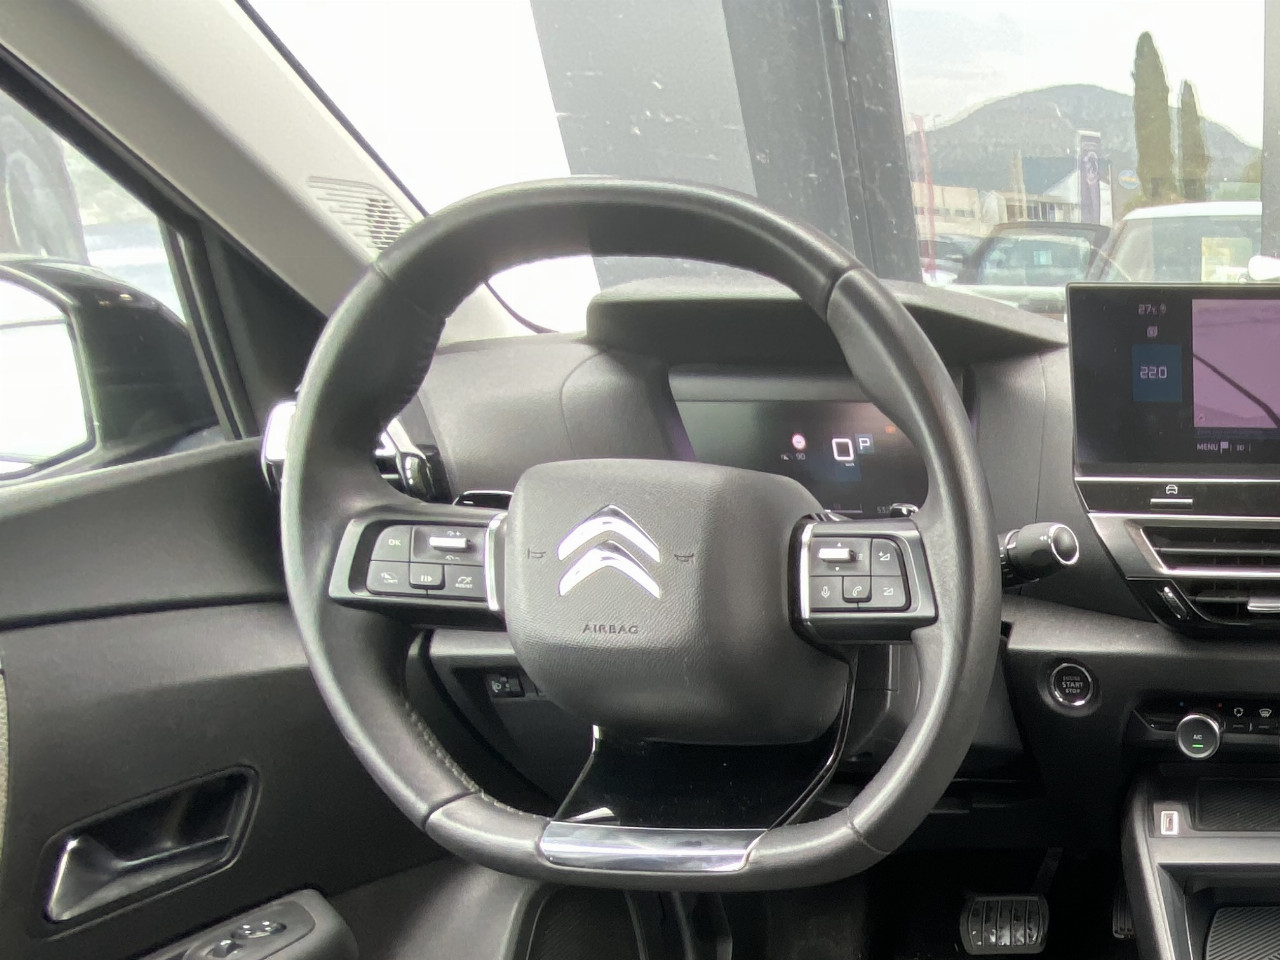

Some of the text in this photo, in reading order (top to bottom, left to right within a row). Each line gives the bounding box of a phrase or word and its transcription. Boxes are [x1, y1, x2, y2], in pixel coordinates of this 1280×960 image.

[859, 438, 870, 450] P
[1197, 443, 1218, 451] MENU
[388, 538, 401, 546] OK
[582, 624, 639, 634] AIRBAG
